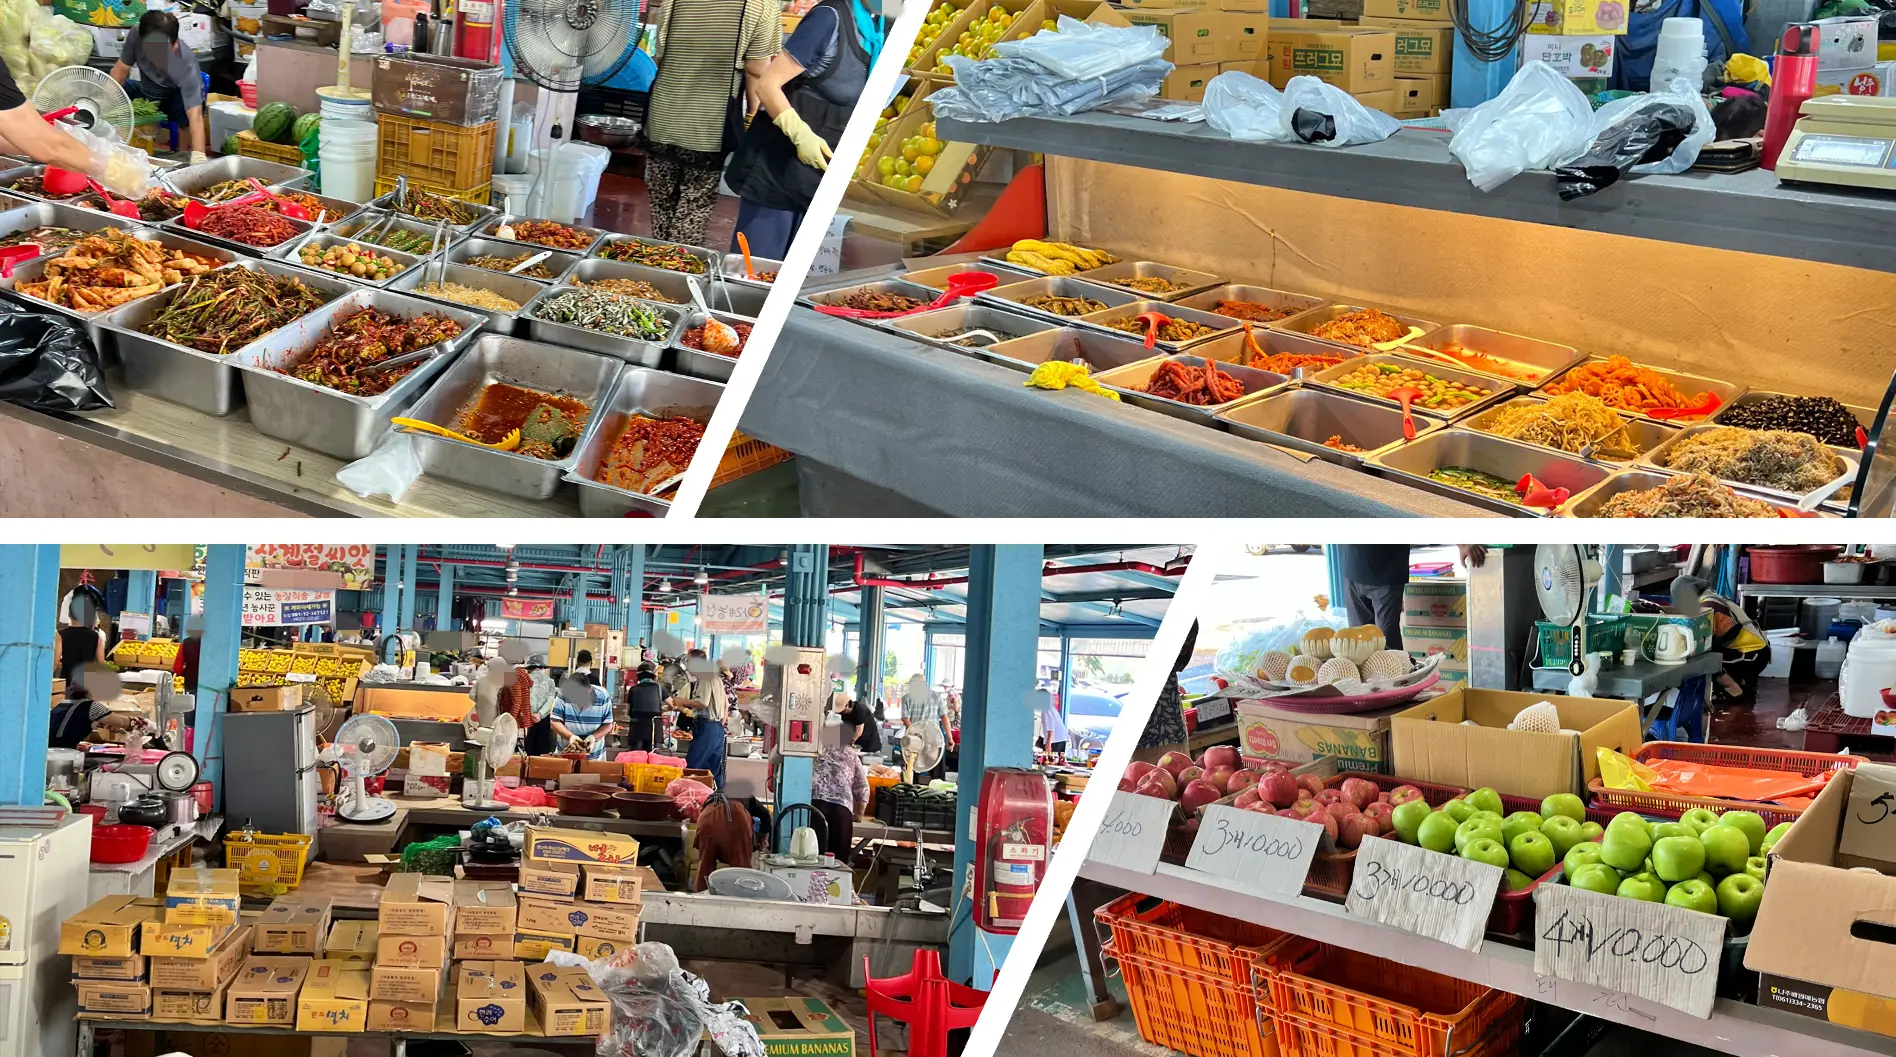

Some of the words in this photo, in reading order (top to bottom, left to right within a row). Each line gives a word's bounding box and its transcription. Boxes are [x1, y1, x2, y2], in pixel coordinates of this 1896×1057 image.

[1396, 38, 1431, 53] 러그묘
[1547, 43, 1561, 51] 미니
[1295, 51, 1342, 67] 프러그묘
[1541, 52, 1572, 62] 단호박
[255, 591, 272, 601] 있는
[274, 591, 309, 601] 농장직송
[251, 603, 275, 612] 농사꾼
[243, 613, 276, 624] 받아요
[1317, 741, 1377, 758] BANANAS
[1337, 759, 1378, 773] Premiu
[1009, 847, 1039, 856] 소화기
[169, 934, 193, 950] 멸치
[1772, 994, 1823, 1011] T(061)334-2365
[325, 1009, 350, 1025] 멸치
[764, 1044, 799, 1055] EMIUM
[801, 1042, 849, 1055] BANANAS
